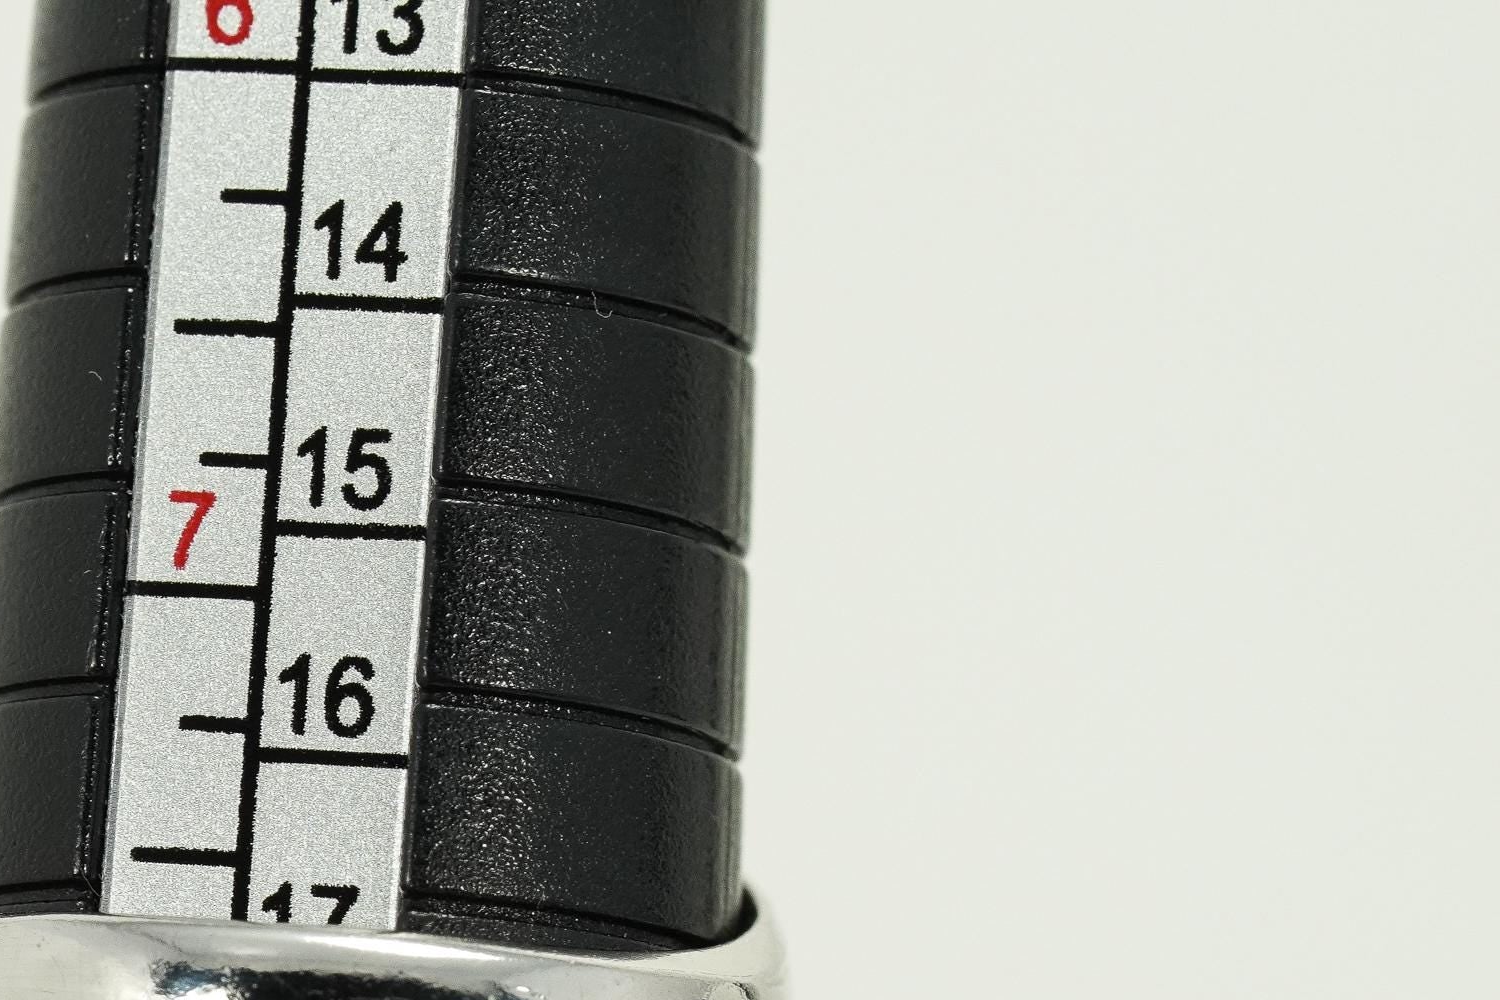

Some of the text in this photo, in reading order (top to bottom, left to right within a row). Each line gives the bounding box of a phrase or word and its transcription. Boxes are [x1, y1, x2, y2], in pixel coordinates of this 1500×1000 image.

[331, 0, 425, 56] 13
[314, 199, 409, 283] 14
[297, 426, 393, 511] 15
[168, 490, 217, 570] 7
[278, 652, 376, 738] 16
